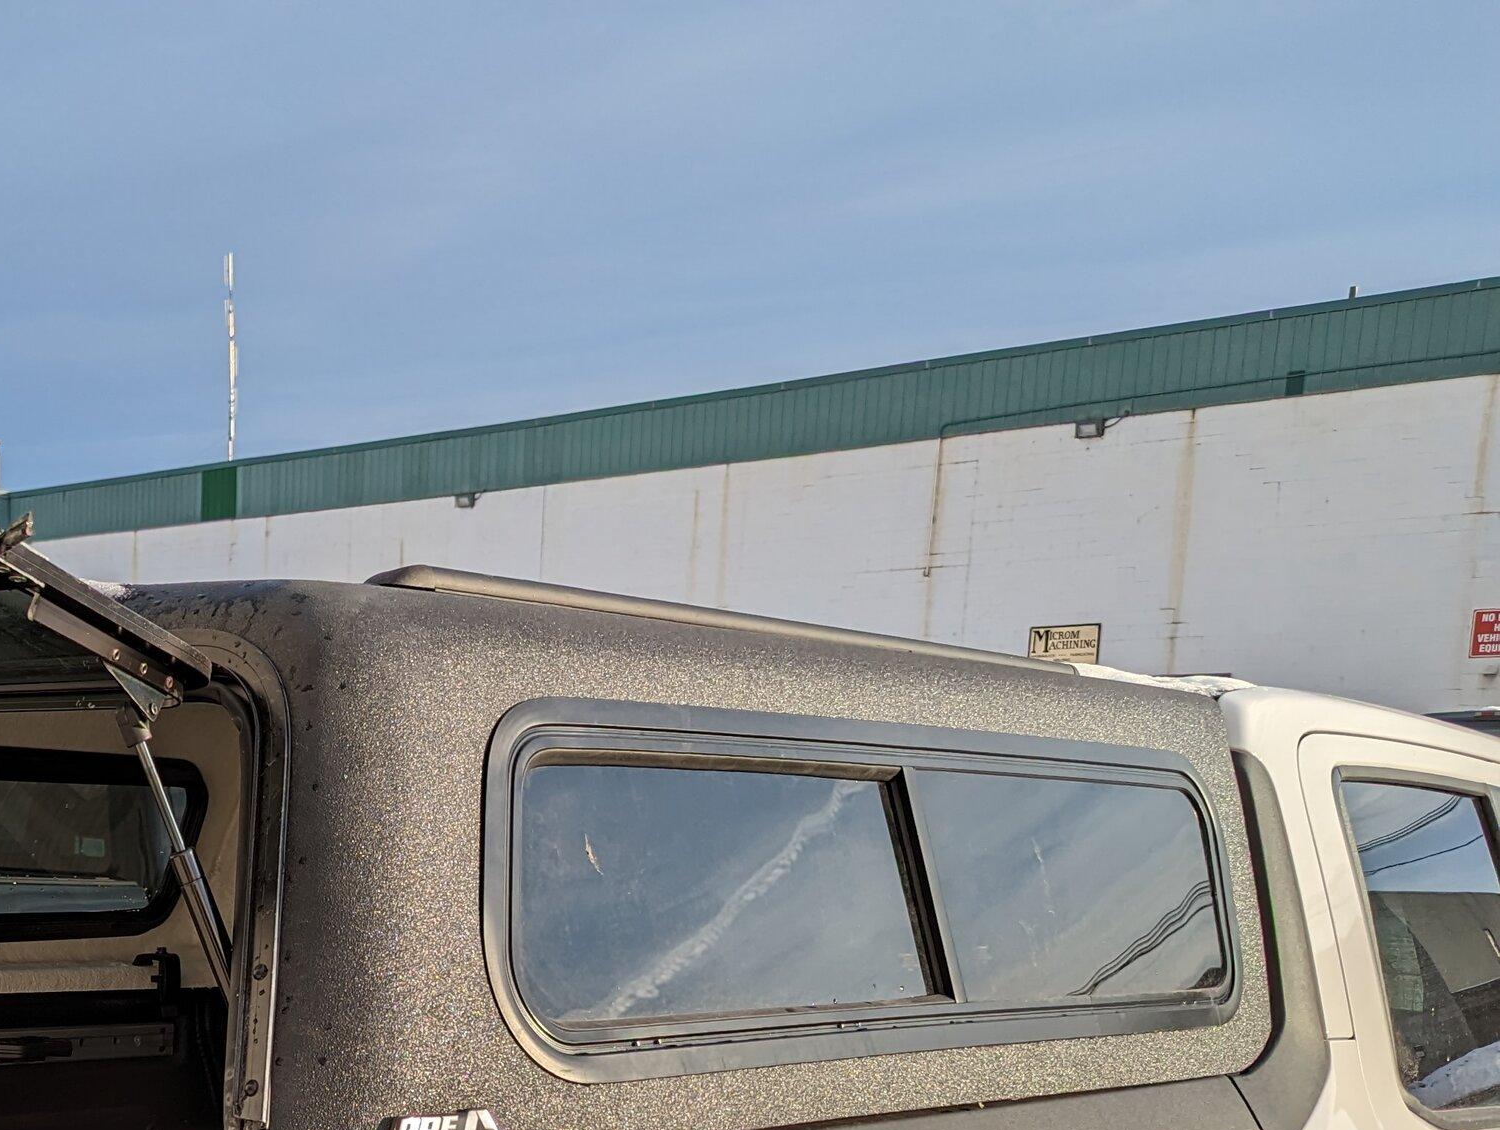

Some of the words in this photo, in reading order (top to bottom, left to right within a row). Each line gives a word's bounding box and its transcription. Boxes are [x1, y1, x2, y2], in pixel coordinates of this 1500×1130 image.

[1482, 613, 1495, 622] NO
[1477, 633, 1500, 642] VEHI
[1479, 643, 1500, 653] EQUI
